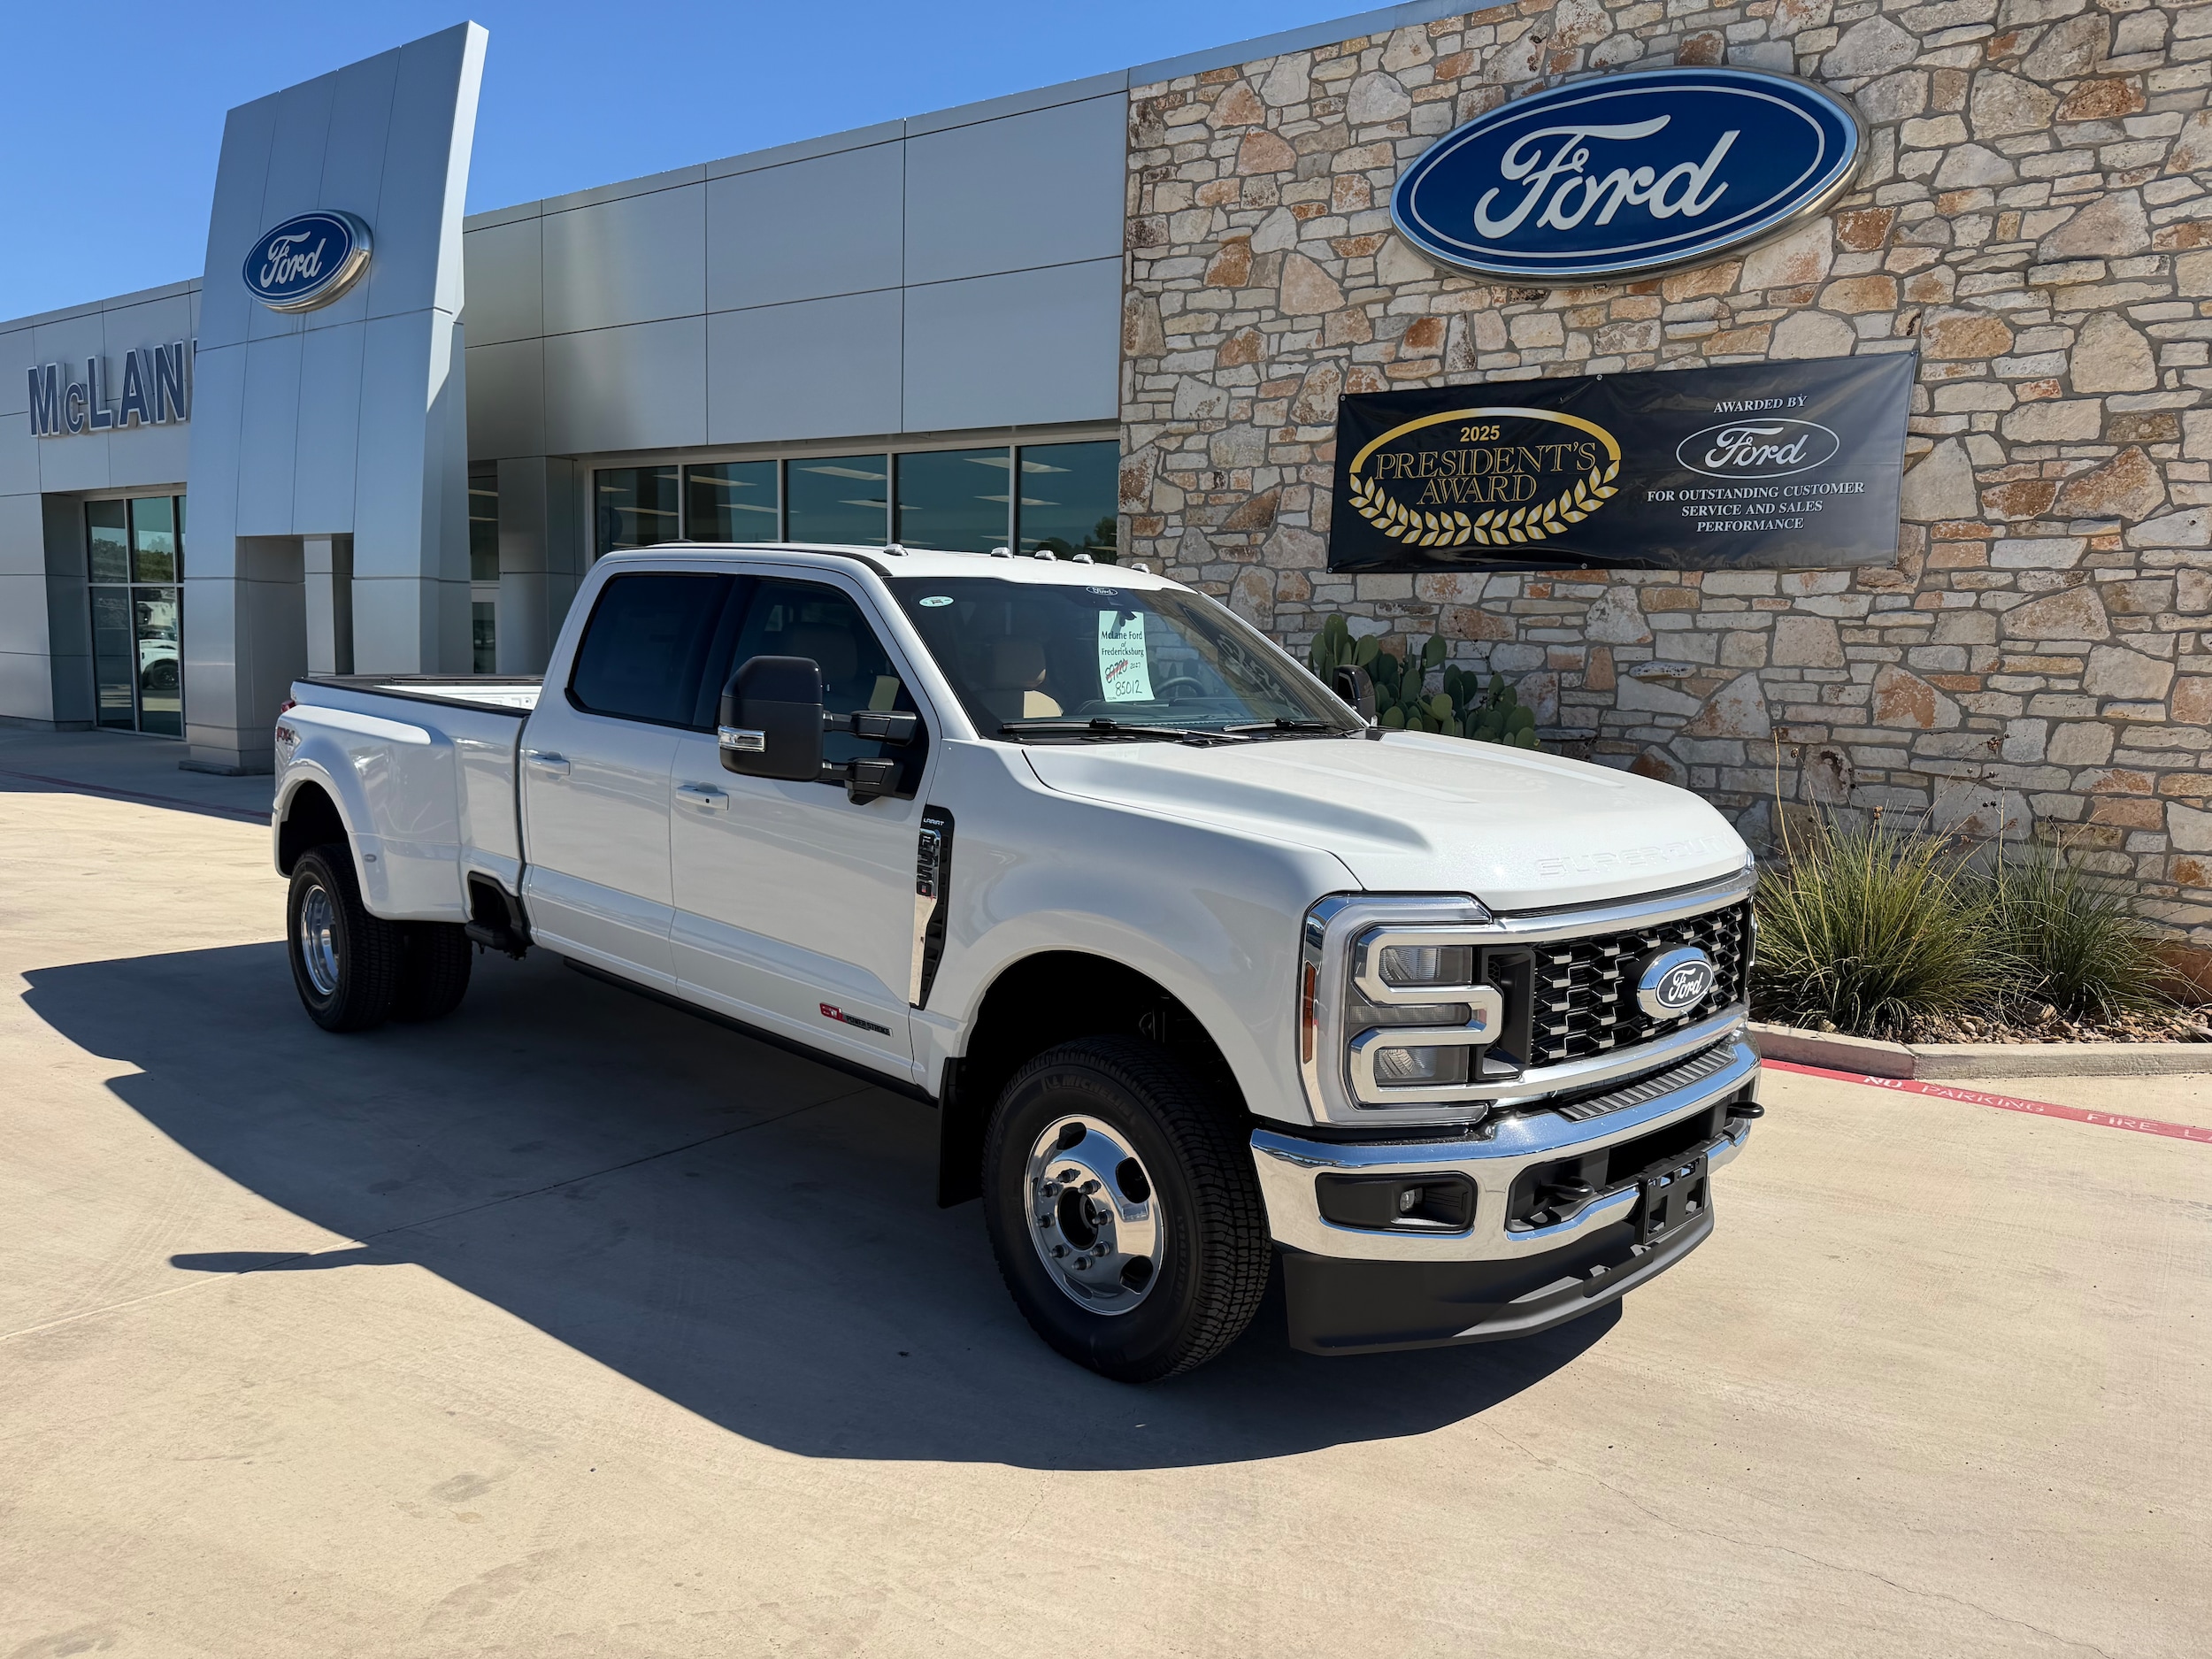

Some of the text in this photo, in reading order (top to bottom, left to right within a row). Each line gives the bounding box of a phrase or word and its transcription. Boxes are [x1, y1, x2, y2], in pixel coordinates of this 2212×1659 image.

[1473, 114, 1740, 239] Ford
[260, 231, 326, 288] Ford
[27, 336, 197, 437] McLAN
[1713, 396, 1807, 413] AWARDED BY
[1460, 425, 1501, 442] 2025
[1704, 426, 1809, 468] Ford
[1374, 442, 1597, 480] PRESIDENT'S
[1416, 474, 1537, 505] AWARD
[1647, 481, 1865, 503] FOR OUTSTANDING CUSTOMER
[1681, 500, 1824, 518] SERVICE AND SALES
[1696, 518, 1805, 533] PERFORMANCE
[1101, 631, 1143, 640] McLane Ford
[1102, 648, 1145, 657] Fredericksburg
[1115, 680, 1143, 696] 85012
[1535, 847, 1671, 876] SUPER
[1668, 967, 1704, 1002] Ford
[1061, 1074, 1134, 1119] MICHELIN
[1863, 1076, 2212, 1141] NO PARKING FIRE L
